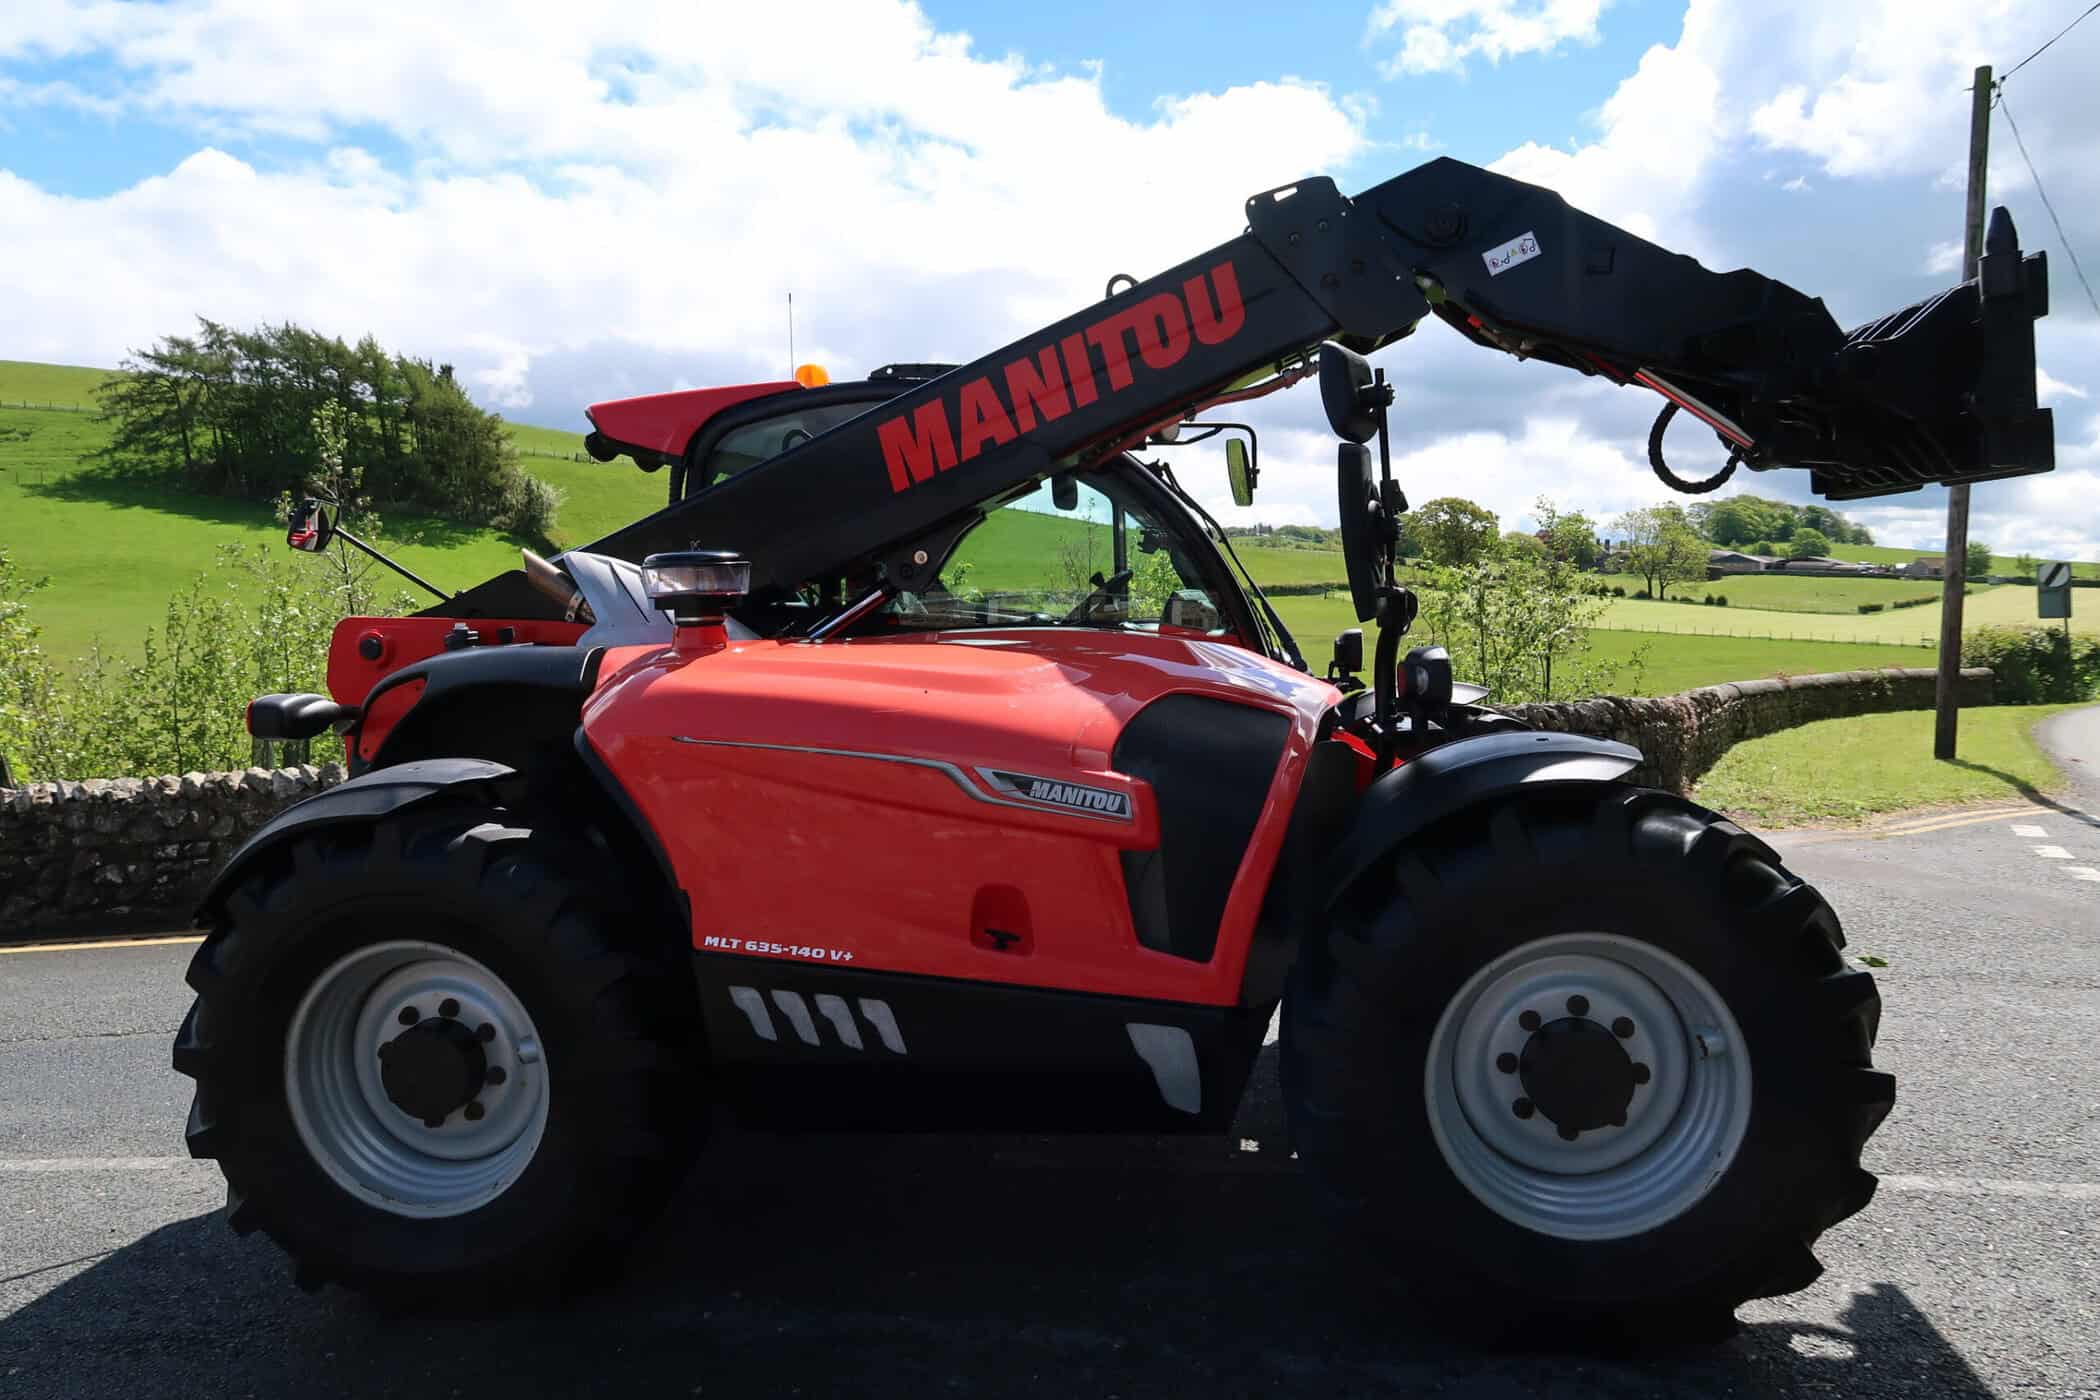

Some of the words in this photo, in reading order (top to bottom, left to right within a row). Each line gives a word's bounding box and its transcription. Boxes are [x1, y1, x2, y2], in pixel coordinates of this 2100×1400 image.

[876, 260, 1247, 495] MANITOU
[1029, 780, 1122, 812] MANITOU
[704, 936, 742, 949] MLT
[745, 940, 825, 959] 635-140
[830, 949, 854, 961] V+
